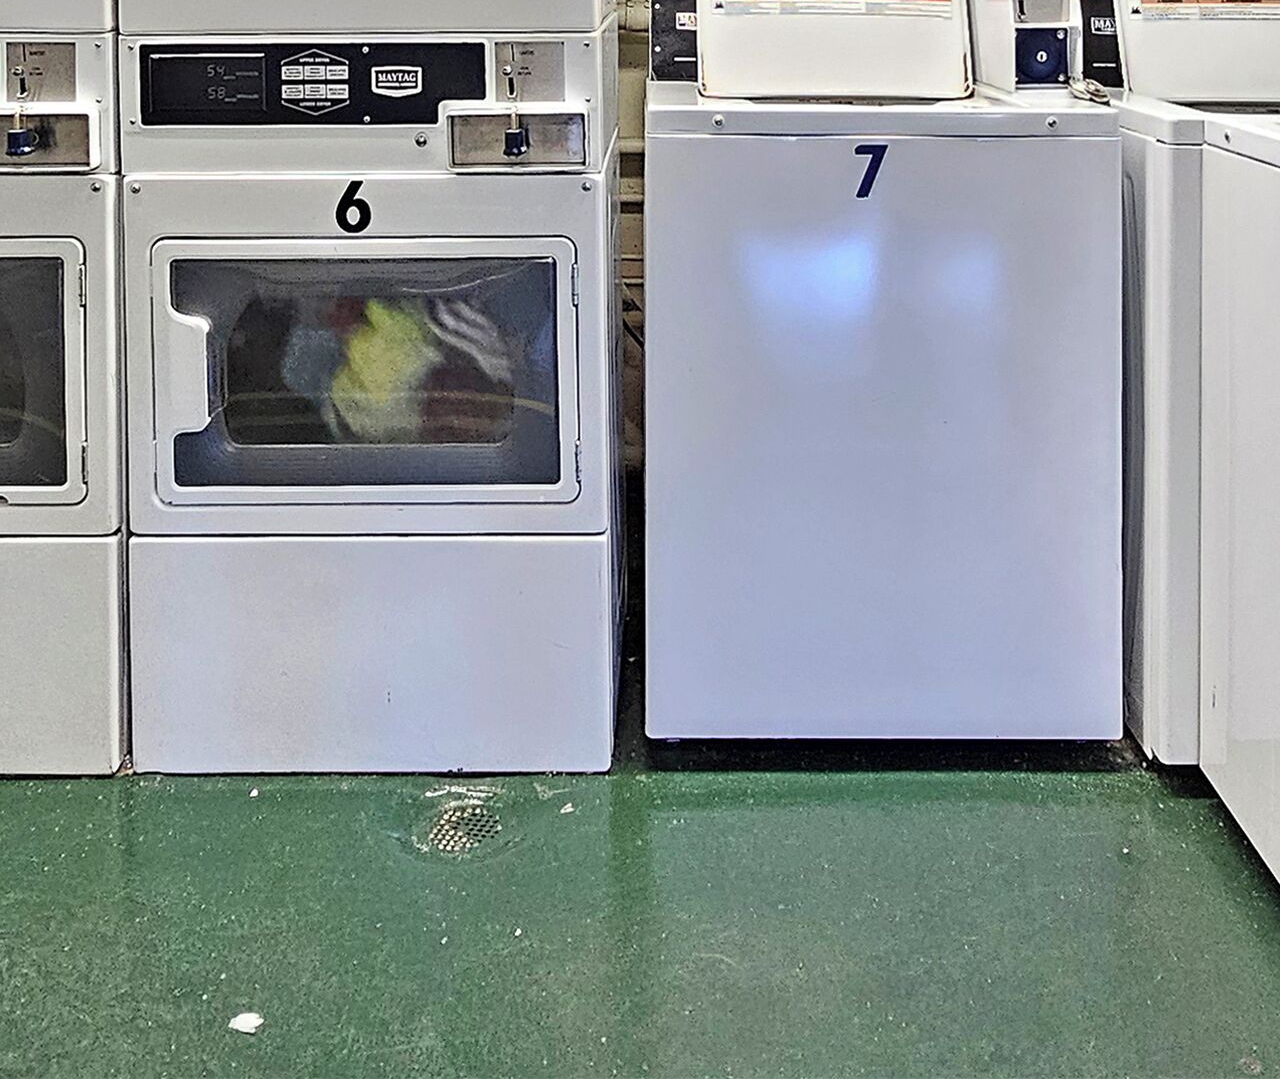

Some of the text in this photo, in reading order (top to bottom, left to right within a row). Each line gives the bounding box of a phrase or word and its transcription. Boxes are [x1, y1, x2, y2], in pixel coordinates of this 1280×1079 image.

[207, 64, 225, 77] 54
[377, 72, 417, 81] MAYTAG
[208, 86, 225, 99] 58
[854, 144, 889, 199] 7
[335, 180, 372, 234] 6
